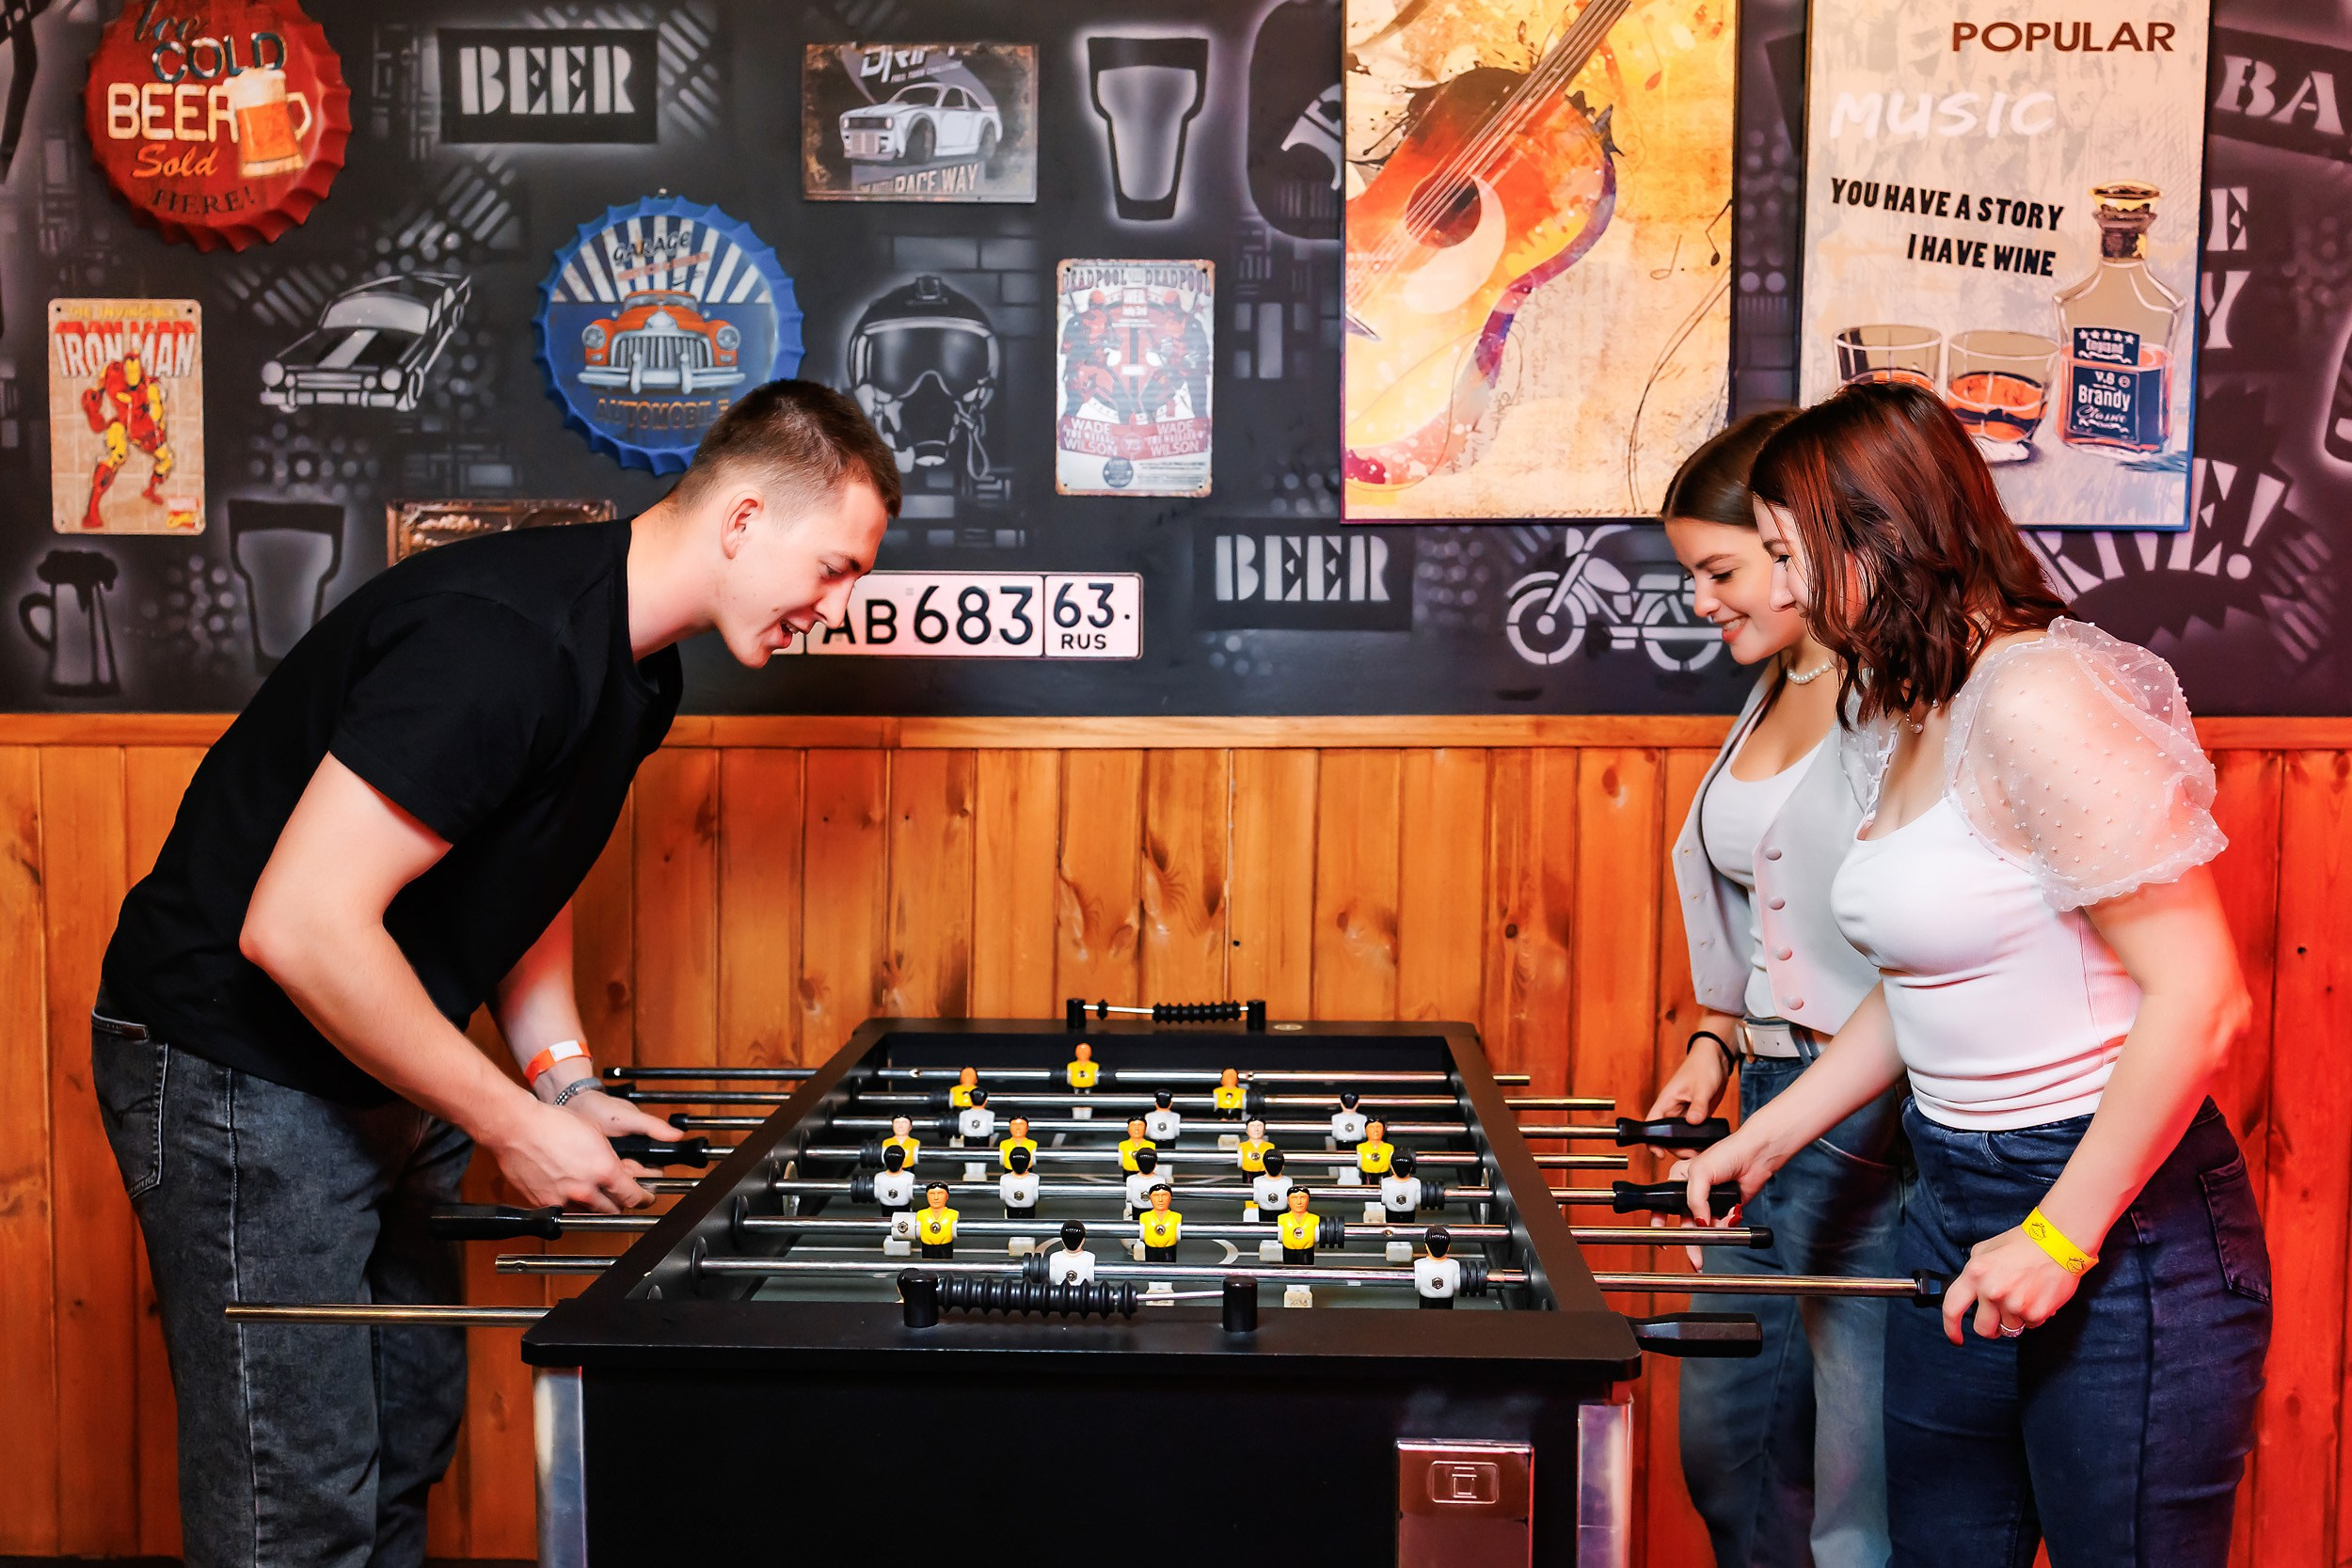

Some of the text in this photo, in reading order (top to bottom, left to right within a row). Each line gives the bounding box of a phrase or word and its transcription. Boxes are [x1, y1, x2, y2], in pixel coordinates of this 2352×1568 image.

[151, 32, 287, 83] COLD
[1952, 22, 2176, 52] POPULAR
[459, 45, 635, 115] BEER
[2214, 55, 2352, 139] BA
[107, 83, 239, 143] BEER
[1829, 91, 2056, 139] MUSIC
[133, 144, 219, 178] Sold
[943, 163, 980, 193] WAY
[151, 185, 256, 214] HERE!
[1832, 178, 2064, 230] YOU HAVE A STORY
[613, 231, 691, 265] GARAGE
[1907, 233, 2057, 277] I HAVE WINE
[55, 322, 196, 376] IRON MAN
[2078, 385, 2130, 412] Brandy
[1216, 534, 1391, 601] BEER
[914, 585, 1033, 645] 683
[1054, 582, 1114, 628] 63
[1061, 633, 1106, 650] RUS
